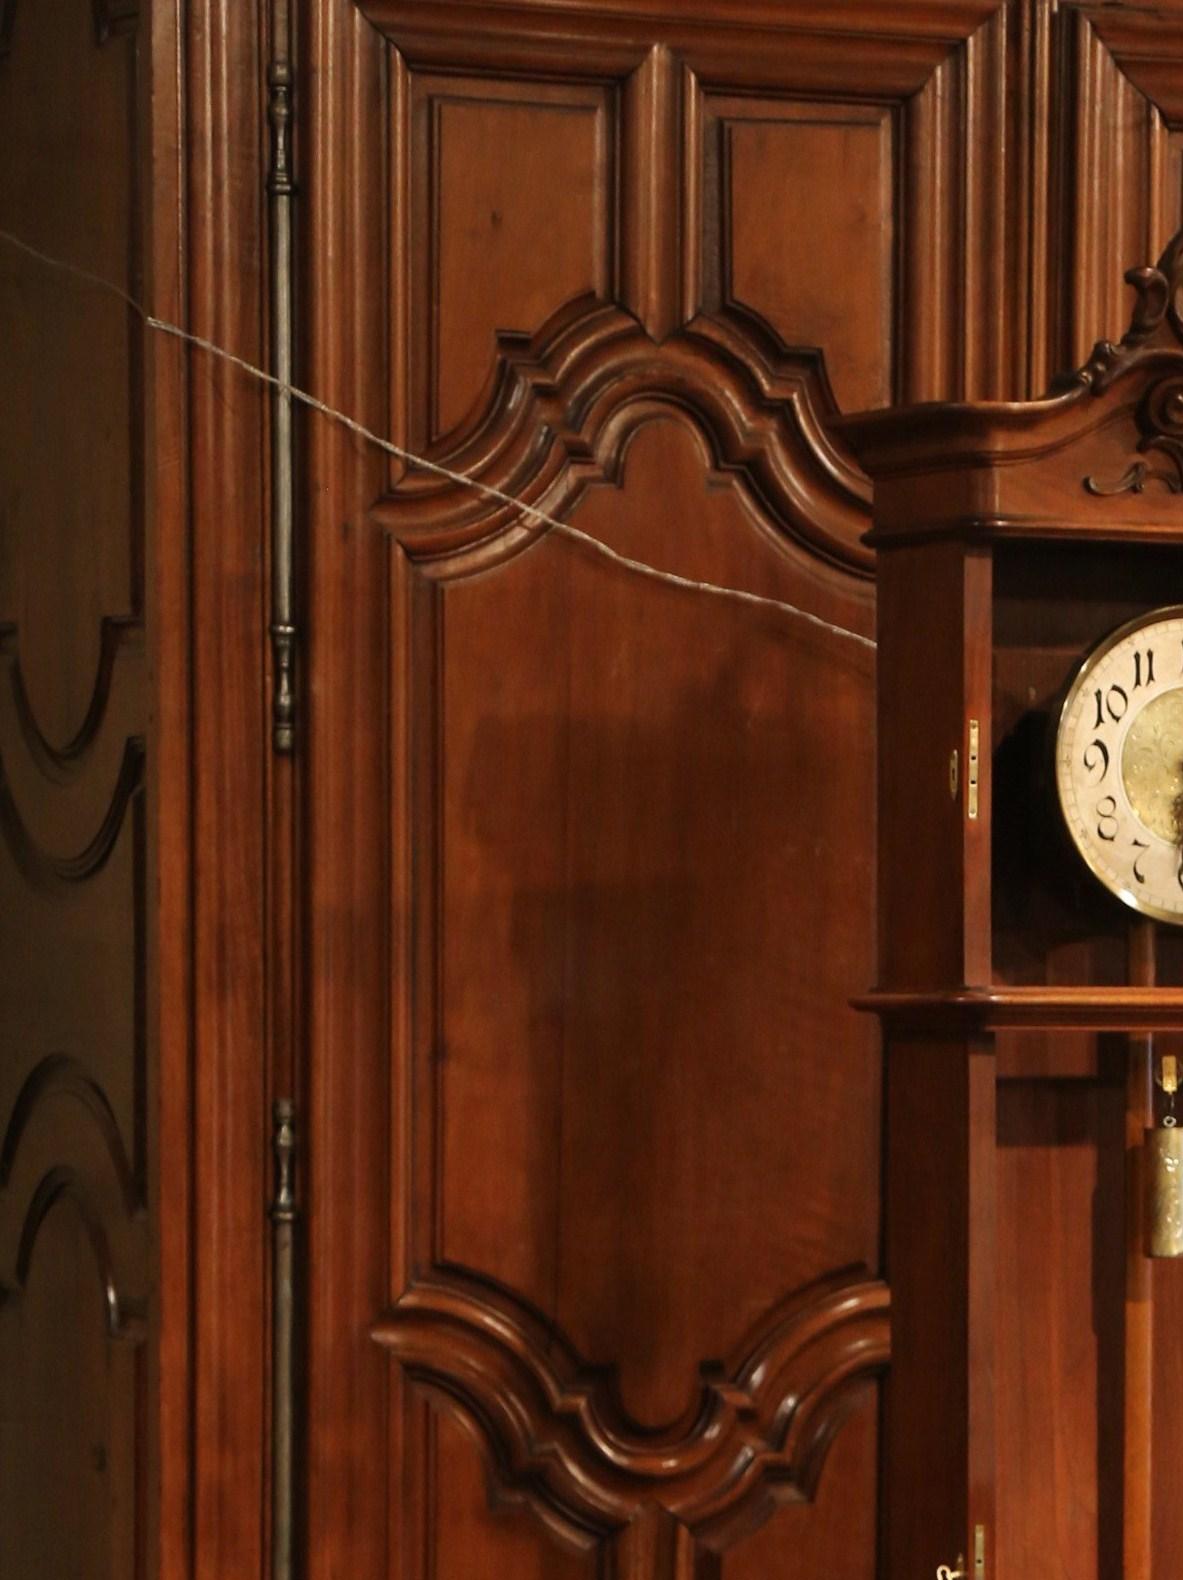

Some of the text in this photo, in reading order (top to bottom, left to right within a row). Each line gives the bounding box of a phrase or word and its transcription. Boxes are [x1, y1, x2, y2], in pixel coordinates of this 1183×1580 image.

[1133, 648, 1155, 690] 11
[1094, 684, 1128, 729] 10
[1083, 739, 1109, 784] 9
[1096, 795, 1120, 841] 8
[1131, 840, 1150, 884] 7
